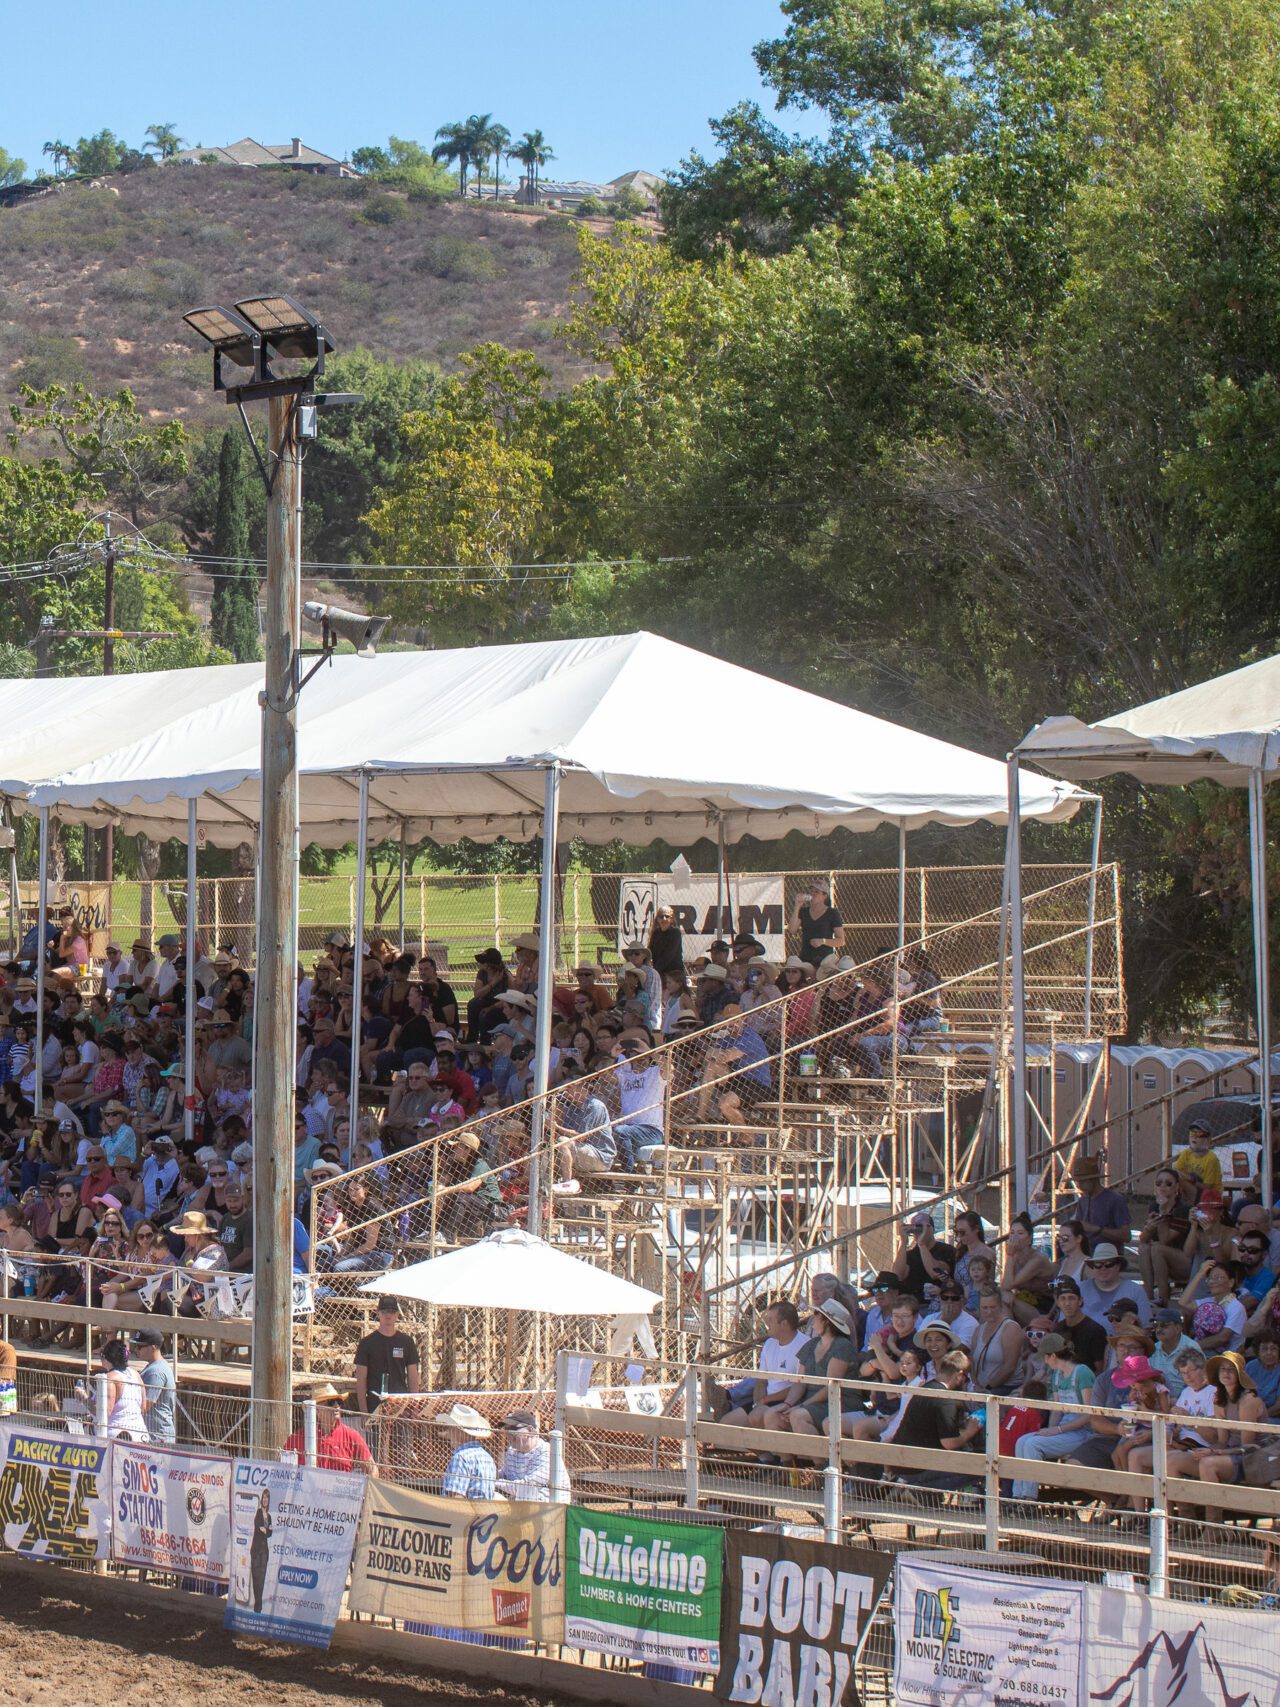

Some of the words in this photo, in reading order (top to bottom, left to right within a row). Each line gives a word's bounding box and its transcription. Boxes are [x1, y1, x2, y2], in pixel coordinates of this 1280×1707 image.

[670, 905, 783, 935] RAM
[13, 1439, 61, 1464] PACIFIC
[62, 1447, 98, 1469] AUTO
[129, 1451, 152, 1461] POWAY
[122, 1458, 159, 1495] SMOG
[168, 1469, 179, 1479] WE
[179, 1470, 187, 1481] DO
[187, 1472, 199, 1484] ALL
[201, 1474, 224, 1487] SMOGS
[251, 1467, 269, 1487] C2
[119, 1492, 163, 1530] STATION
[278, 1502, 305, 1517] GETTING
[305, 1507, 312, 1518] A
[312, 1508, 337, 1522] HOME
[337, 1511, 358, 1525] LOAN
[140, 1528, 207, 1555] 858-486-7664
[313, 1522, 322, 1533] BE
[324, 1523, 345, 1536] HARD
[369, 1523, 452, 1559] WELCOME
[295, 1548, 319, 1560] SIMPLE
[319, 1551, 326, 1561] IT
[326, 1552, 334, 1563] IS
[467, 1513, 561, 1587] Coors
[579, 1527, 707, 1595] Dixieline
[295, 1572, 313, 1584] NOW
[367, 1550, 411, 1575] RODEO
[415, 1559, 451, 1582] FANS
[496, 1595, 528, 1623] Banquet
[580, 1584, 614, 1604] LUMBER
[617, 1593, 624, 1604] &
[626, 1594, 654, 1610] HOME
[656, 1598, 702, 1618] CENTERS
[739, 1555, 874, 1646] BOOT
[993, 1597, 1028, 1609] Residential
[1030, 1602, 1036, 1610] &
[1001, 1612, 1020, 1623] Solar,
[1021, 1614, 1042, 1627] Battery
[568, 1628, 581, 1640] SAN
[582, 1629, 597, 1642] DIEGO
[597, 1632, 617, 1647] COUNTY
[618, 1636, 645, 1652] LOCATIONS
[646, 1643, 654, 1653] TO
[654, 1644, 671, 1656] SERVE
[672, 1647, 686, 1658] YOU!
[907, 1640, 941, 1661] MONIZ
[948, 1647, 995, 1671] ELECTRIC
[1008, 1641, 1033, 1653] Lighting
[1054, 1648, 1059, 1656] &
[934, 1665, 940, 1676] &
[969, 1670, 987, 1684] INC.
[1031, 1659, 1057, 1670] Controls
[902, 1681, 920, 1693] Now
[922, 1684, 946, 1700] Hiring
[1000, 1678, 1067, 1699] 760.688.0437
